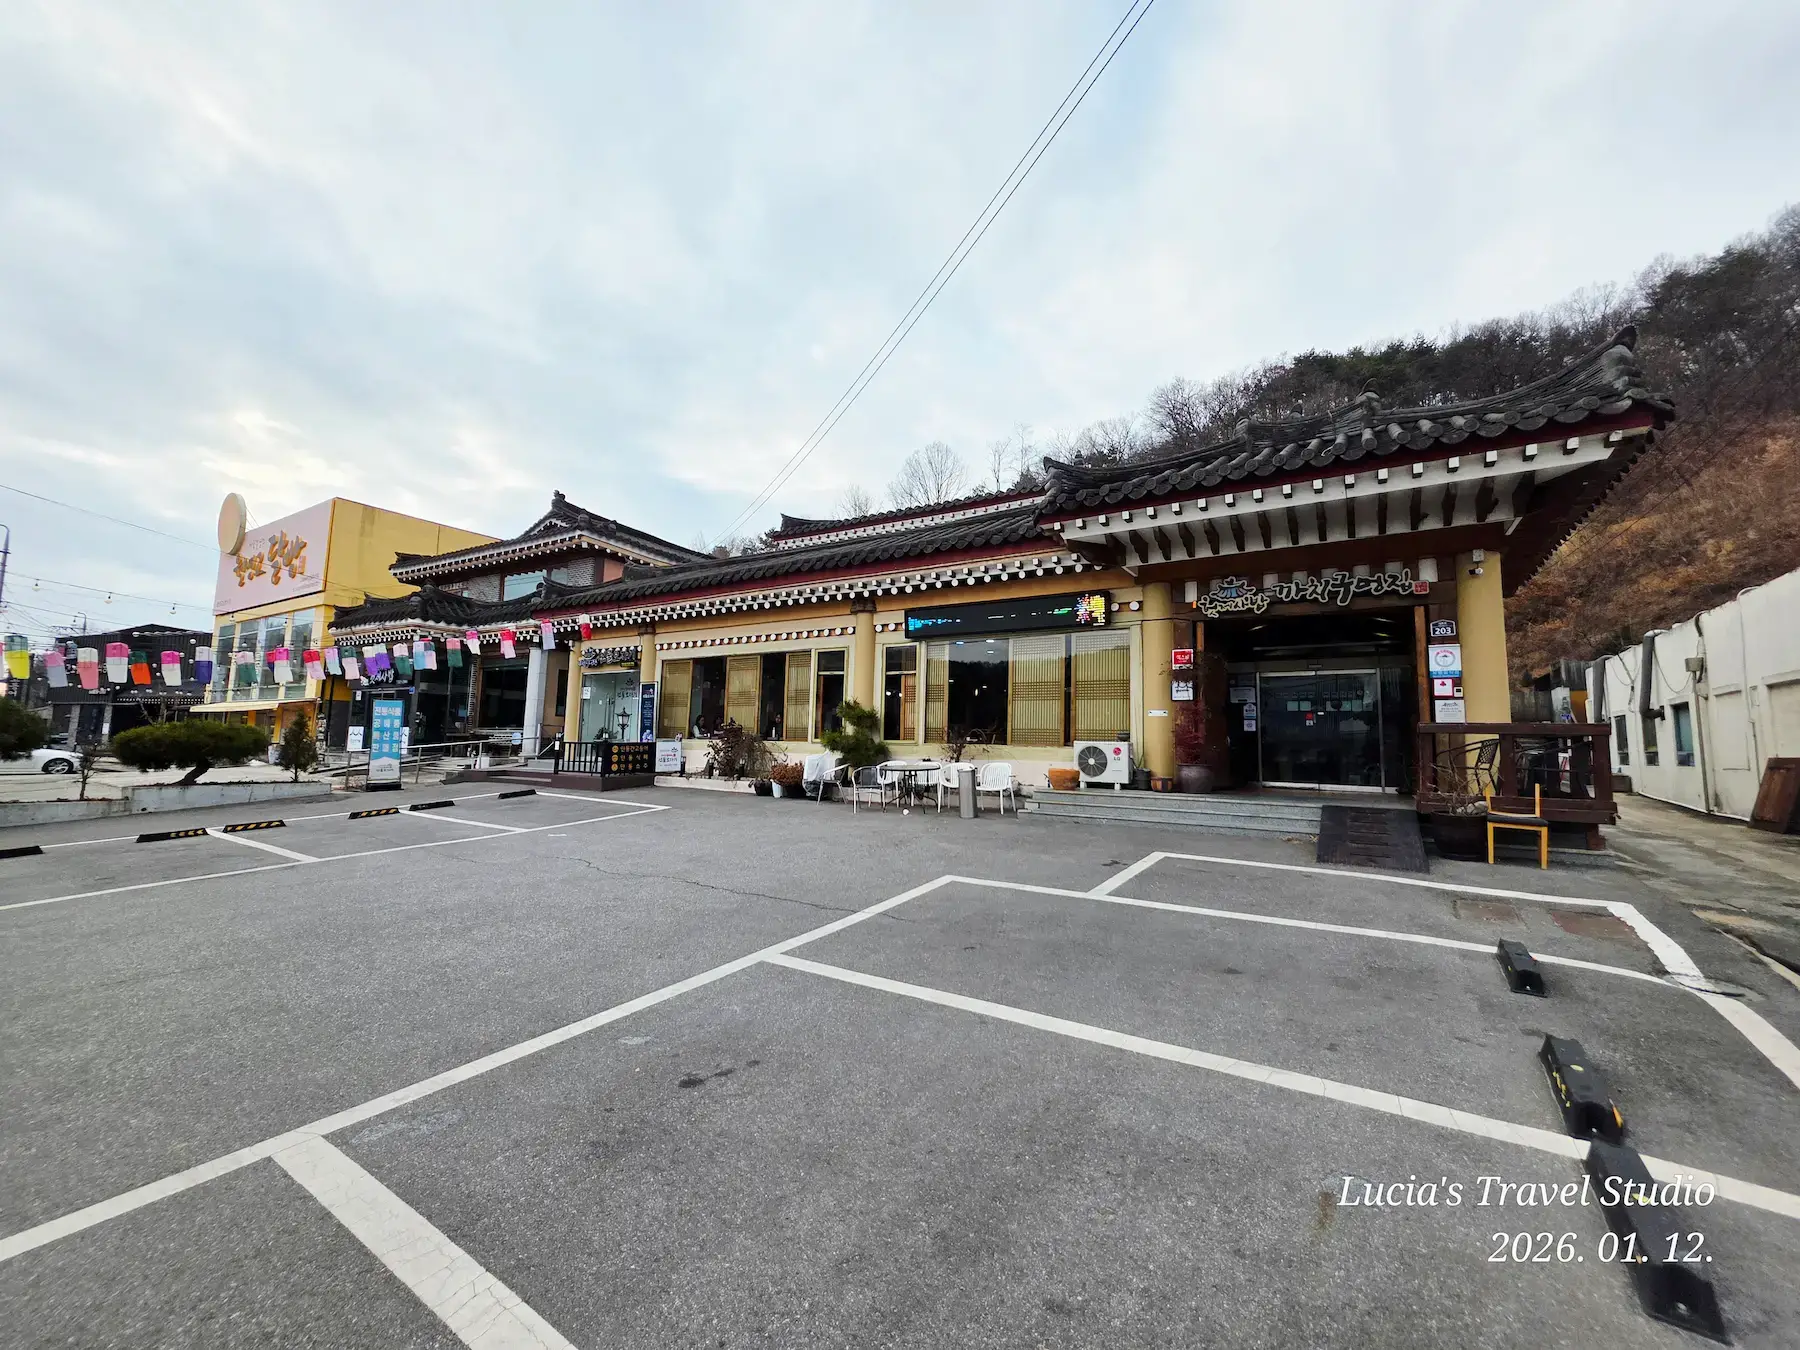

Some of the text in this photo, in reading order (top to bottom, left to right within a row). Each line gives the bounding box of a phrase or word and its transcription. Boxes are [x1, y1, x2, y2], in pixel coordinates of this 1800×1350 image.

[1271, 568, 1413, 605] 까치구멍집
[1198, 593, 1270, 617] 헛제사밥
[1434, 627, 1452, 635] 203
